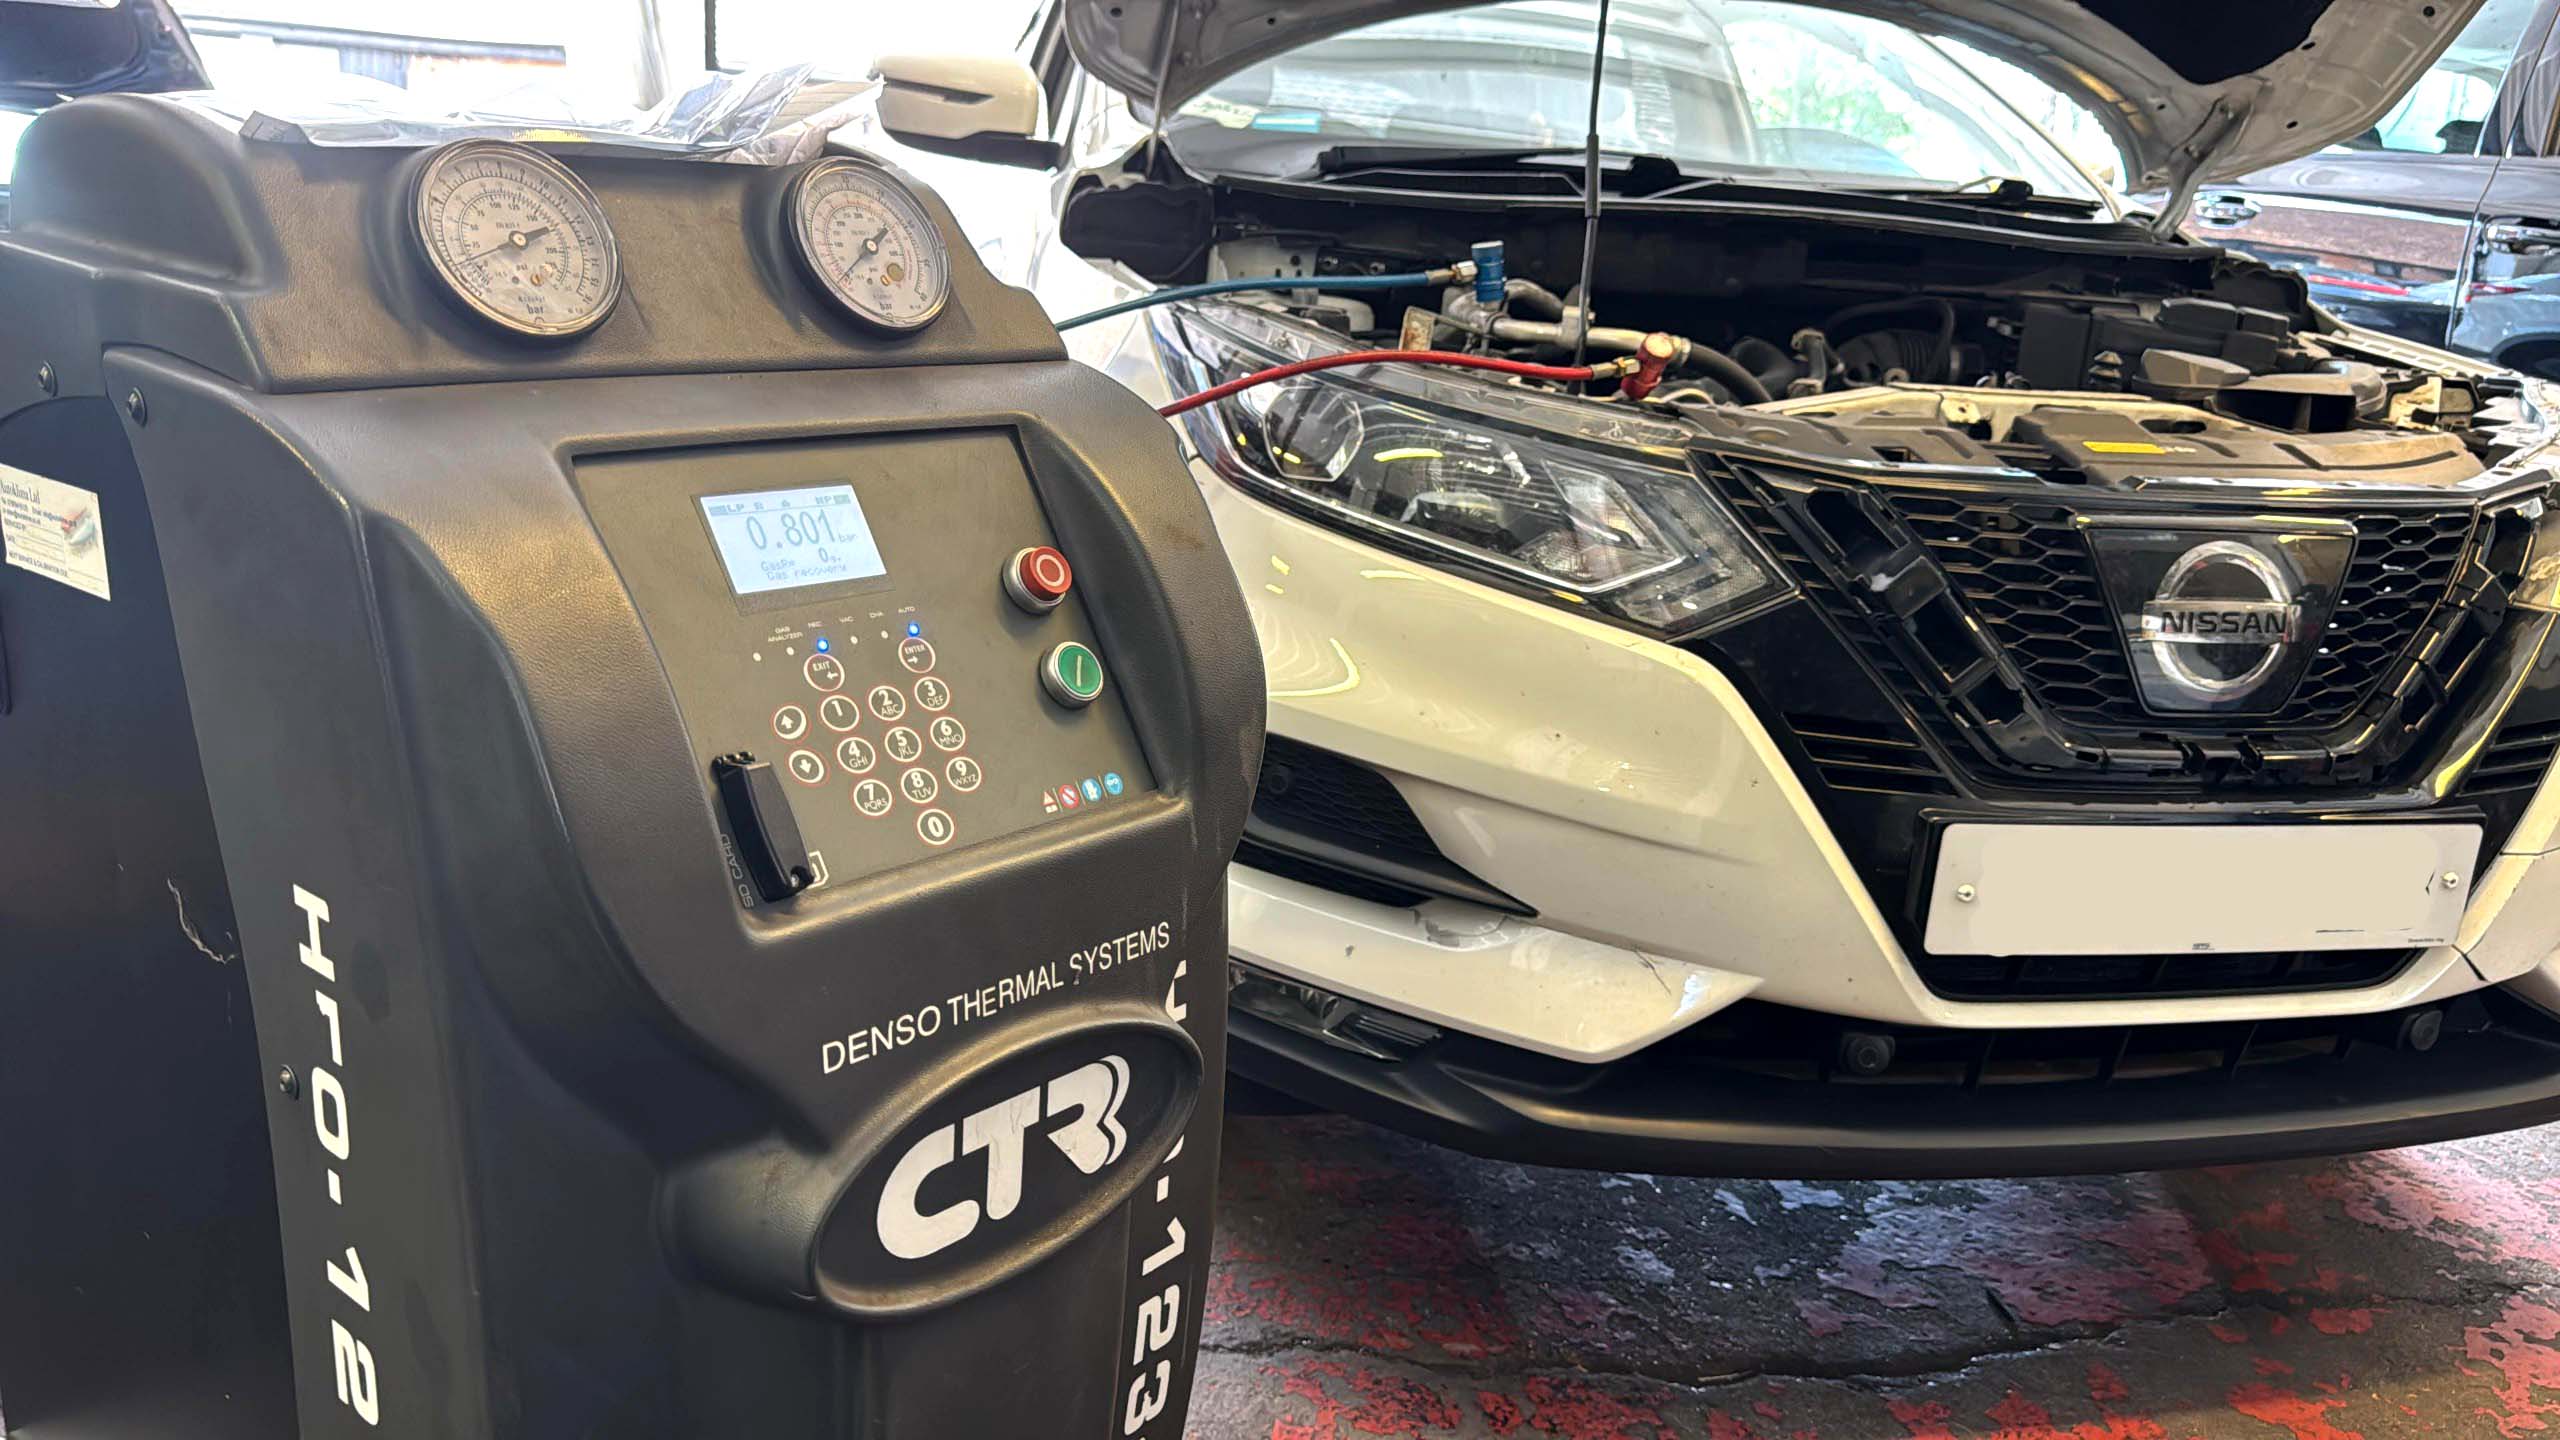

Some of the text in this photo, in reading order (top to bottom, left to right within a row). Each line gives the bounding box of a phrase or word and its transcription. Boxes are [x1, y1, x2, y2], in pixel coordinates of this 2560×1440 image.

[527, 303, 544, 315] bar
[745, 509, 836, 550] 0.801
[817, 547, 830, 564] 0
[2161, 611, 2287, 634] NISSAN
[904, 644, 926, 654] ENTER
[812, 661, 831, 671] EXIT
[923, 681, 937, 697] 3
[878, 690, 893, 706] 2
[926, 695, 945, 707] DEF
[831, 700, 843, 717] 1
[880, 703, 901, 716] ABC
[940, 720, 953, 737] 6
[895, 731, 908, 747] 5
[939, 734, 962, 745] MNO
[848, 740, 861, 758] 4
[897, 745, 915, 759] JKL
[849, 755, 869, 768] GHI
[954, 760, 968, 777] 9
[910, 771, 924, 788] 8
[953, 773, 978, 786] WXYZ
[863, 783, 876, 801] 7
[912, 786, 932, 799] TUV
[863, 798, 889, 810] PQRS
[927, 816, 945, 838] 0
[821, 921, 1171, 1075] DENSO THERMAL SYSTEMS
[876, 1054, 1131, 1260] CTR
